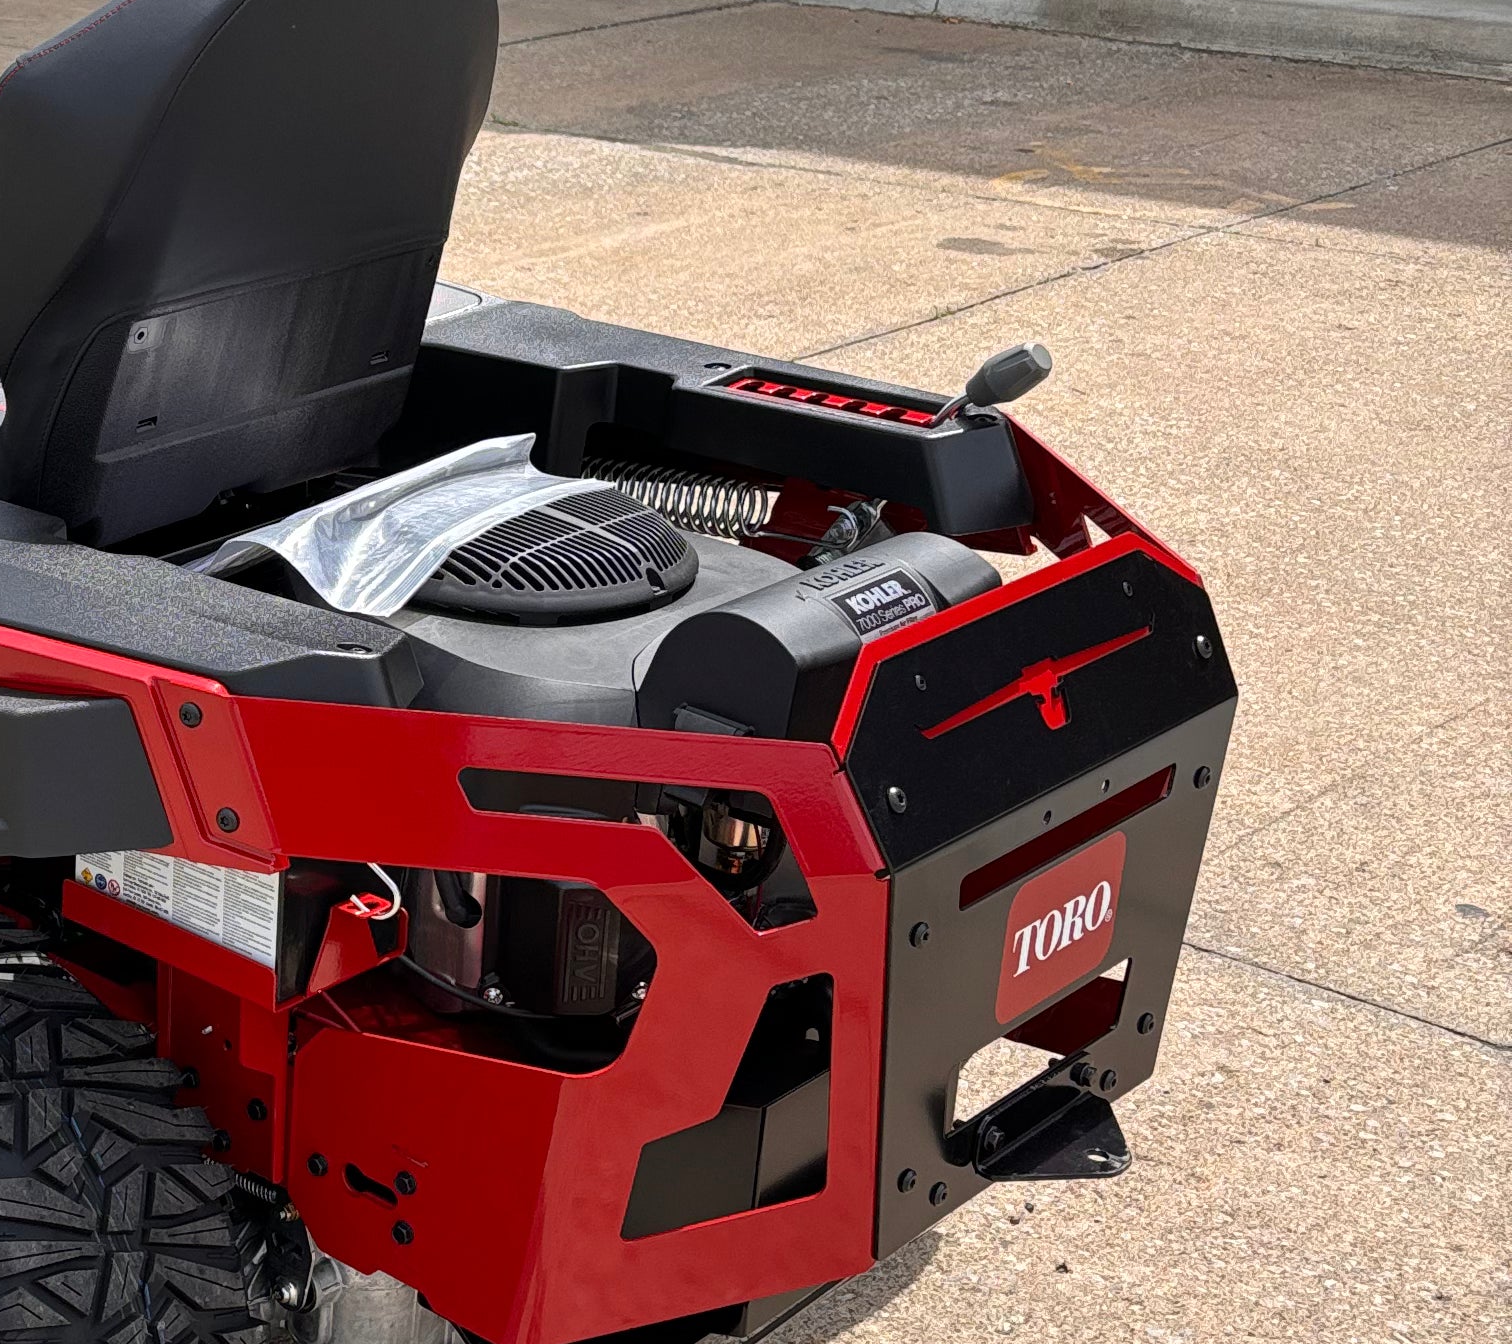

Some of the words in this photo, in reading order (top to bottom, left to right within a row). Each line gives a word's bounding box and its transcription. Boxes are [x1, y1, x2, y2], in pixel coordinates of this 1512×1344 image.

[799, 558, 887, 591] KOHLER
[845, 579, 909, 615] KOHLER
[855, 611, 881, 632] 7000
[878, 604, 907, 625] Series
[904, 593, 926, 612] PRO
[1012, 880, 1112, 978] TORO
